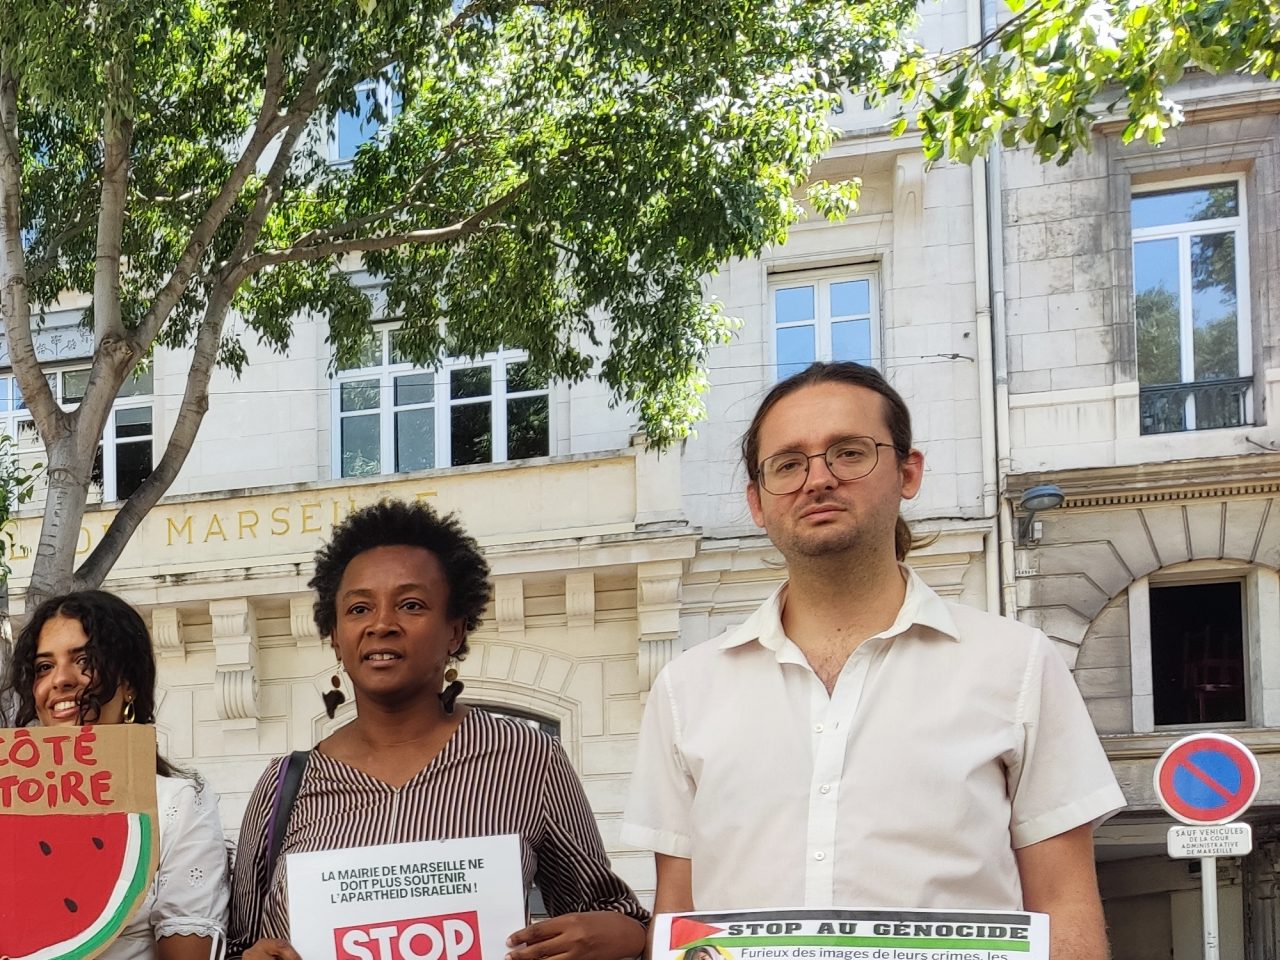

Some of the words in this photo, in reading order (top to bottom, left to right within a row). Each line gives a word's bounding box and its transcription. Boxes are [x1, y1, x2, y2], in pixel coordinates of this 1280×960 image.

[166, 490, 438, 547] MARSEI
[1176, 829, 1197, 837] SAUF
[1181, 841, 1239, 849] ADMINISTRATIVE
[1196, 847, 1232, 855] MARSEILLE
[321, 871, 335, 882] LA
[338, 867, 380, 881] MAIRIE
[382, 865, 397, 876] DE
[399, 860, 466, 875] MARSEILLE
[468, 858, 485, 870] NE
[340, 880, 369, 892] DOIT
[371, 877, 402, 889] PLUS
[404, 871, 466, 887] SOUTENIR
[330, 888, 408, 904] L'APARTHEID
[410, 883, 472, 898] ISRAELIEN
[728, 922, 803, 937] STOP
[817, 922, 858, 936] AU
[873, 920, 1028, 941] GÉNOCIDE
[741, 947, 789, 959] Furieux
[792, 948, 816, 959] des
[819, 948, 870, 960] images
[872, 948, 890, 960] de
[893, 949, 928, 960] leurs
